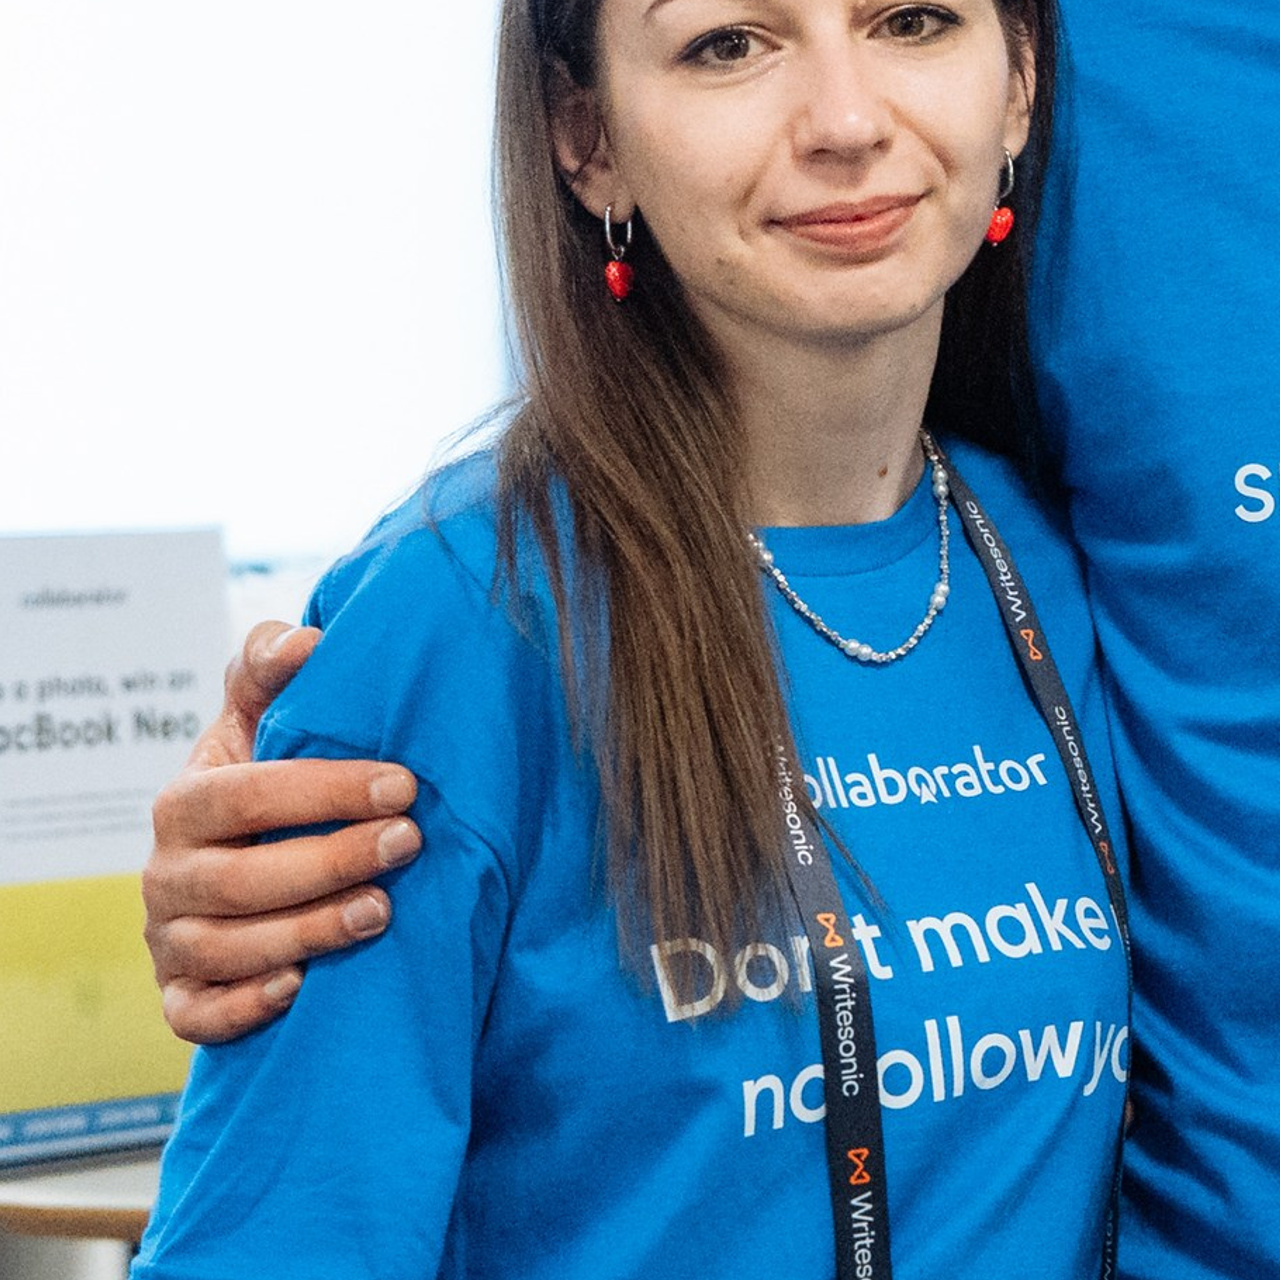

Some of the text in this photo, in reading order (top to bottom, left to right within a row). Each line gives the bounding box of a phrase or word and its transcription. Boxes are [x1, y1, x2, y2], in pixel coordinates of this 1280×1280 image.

[966, 501, 1026, 622] Writesonic
[803, 745, 1047, 808] ollaborator
[1055, 706, 1102, 834] Writesonic
[906, 882, 1112, 973] make
[742, 1015, 1083, 1138] noollow
[829, 953, 864, 1097] Writesonic
